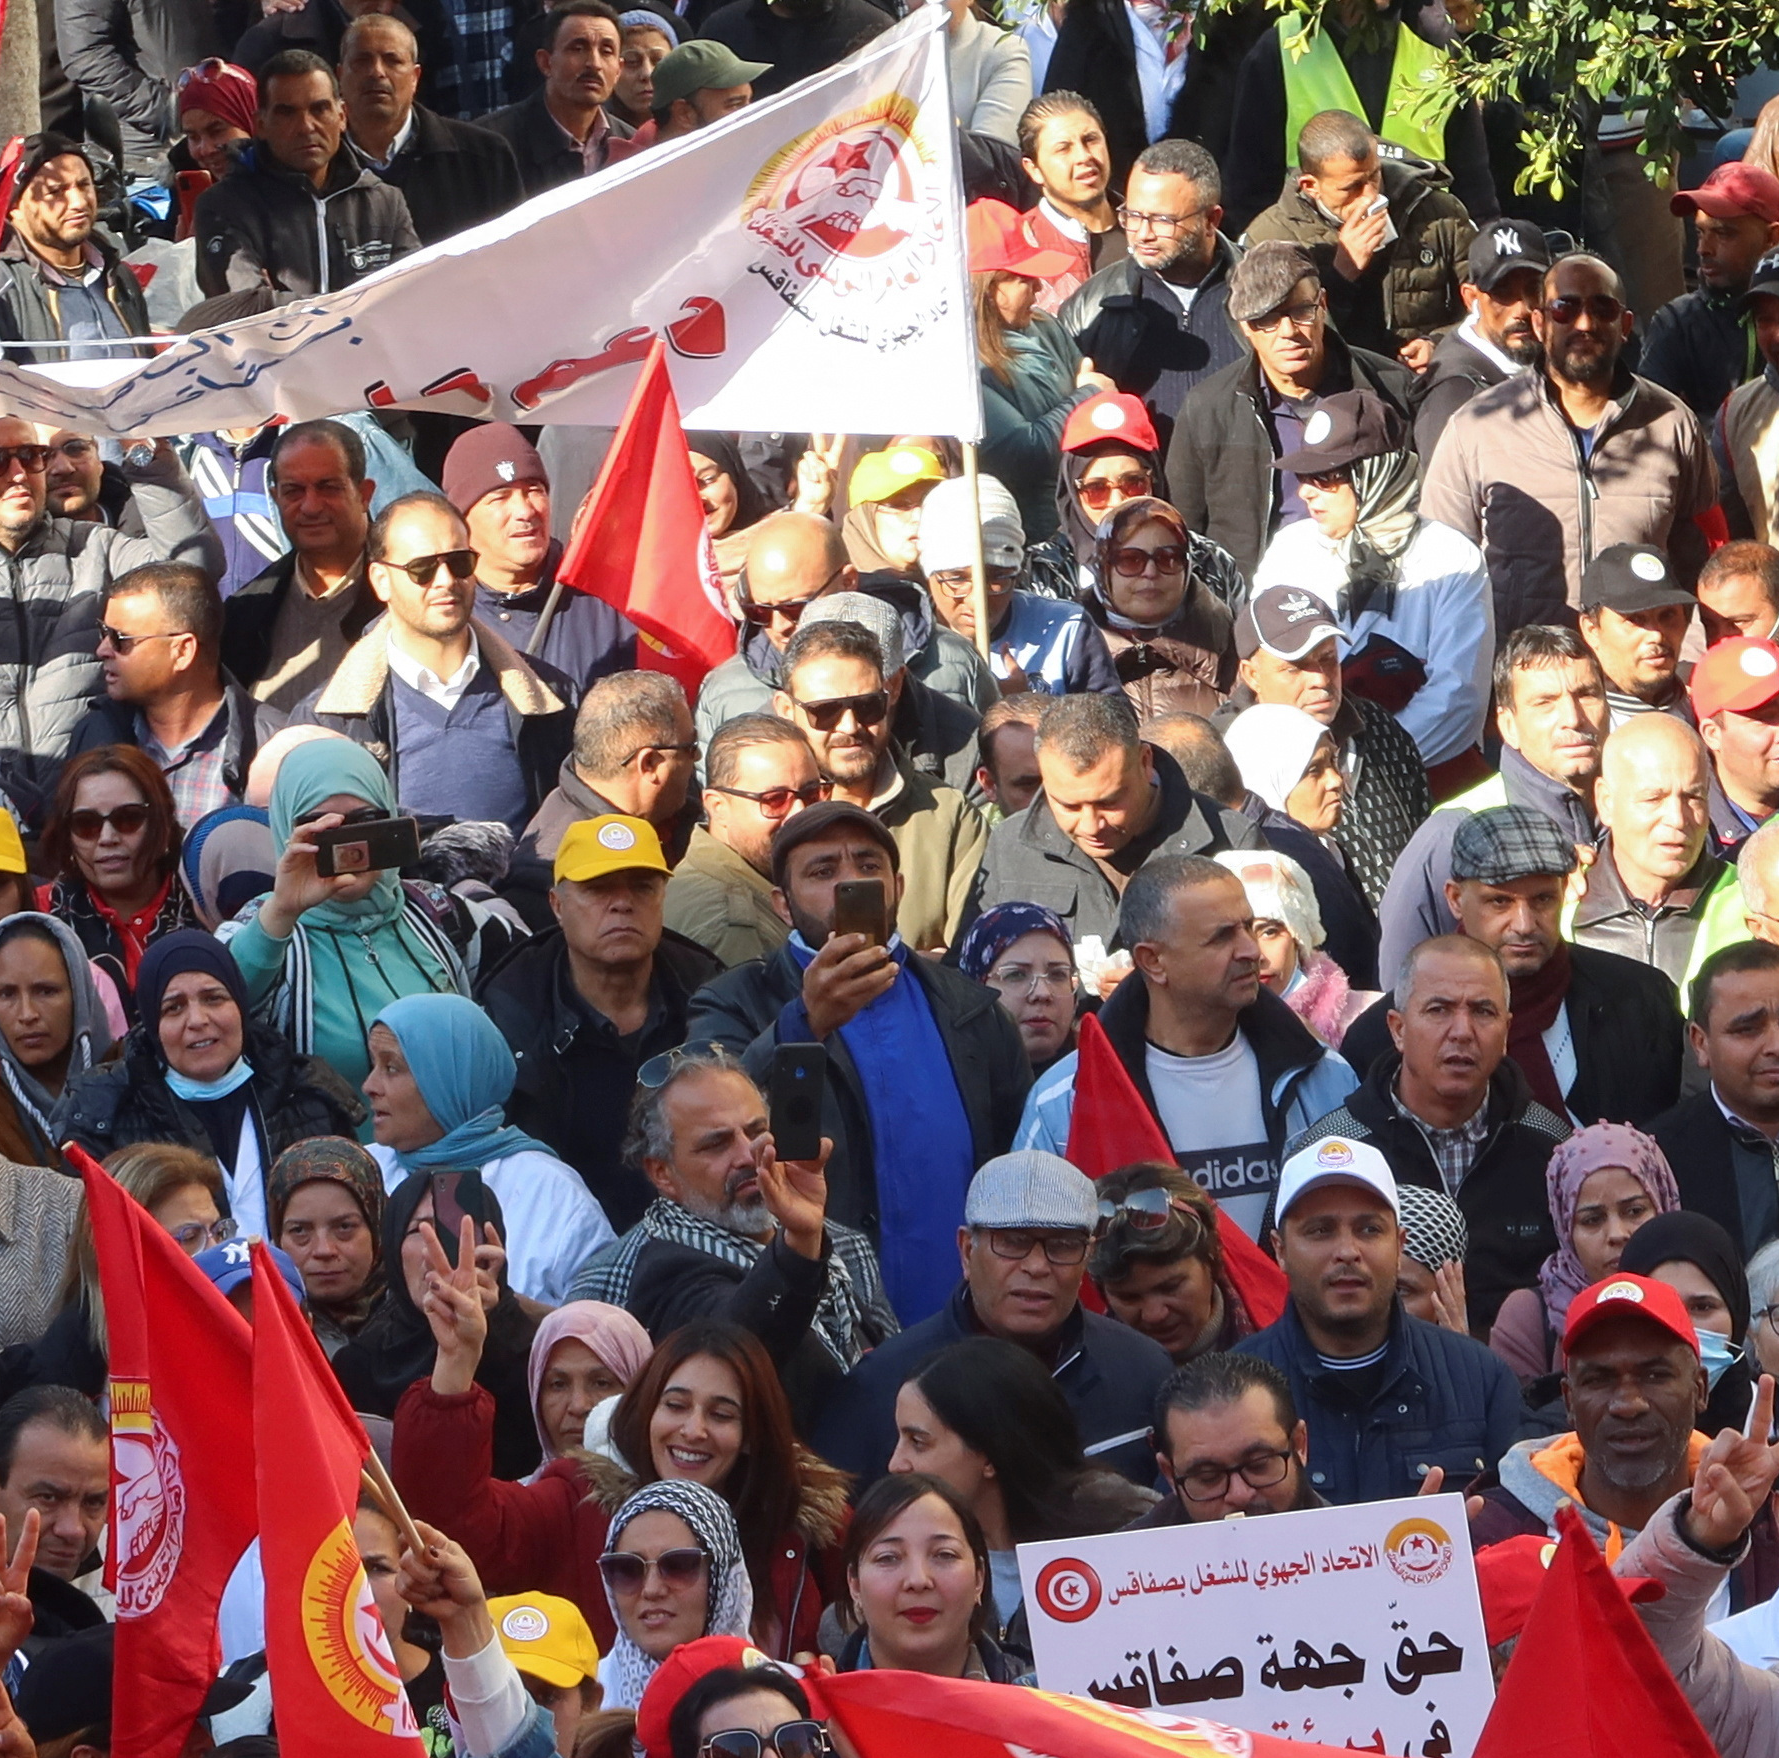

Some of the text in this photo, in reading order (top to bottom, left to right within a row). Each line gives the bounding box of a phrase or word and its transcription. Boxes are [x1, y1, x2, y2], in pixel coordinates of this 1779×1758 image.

[1493, 227, 1522, 256] NY
[1186, 1156, 1279, 1192] didas
[1253, 1550, 1316, 1590] الجهوي
[1321, 1543, 1381, 1575] الاتحاد
[1107, 1570, 1187, 1607] بصفاقس
[1189, 1558, 1249, 1598] للشغل
[1260, 1633, 1367, 1700] جهة
